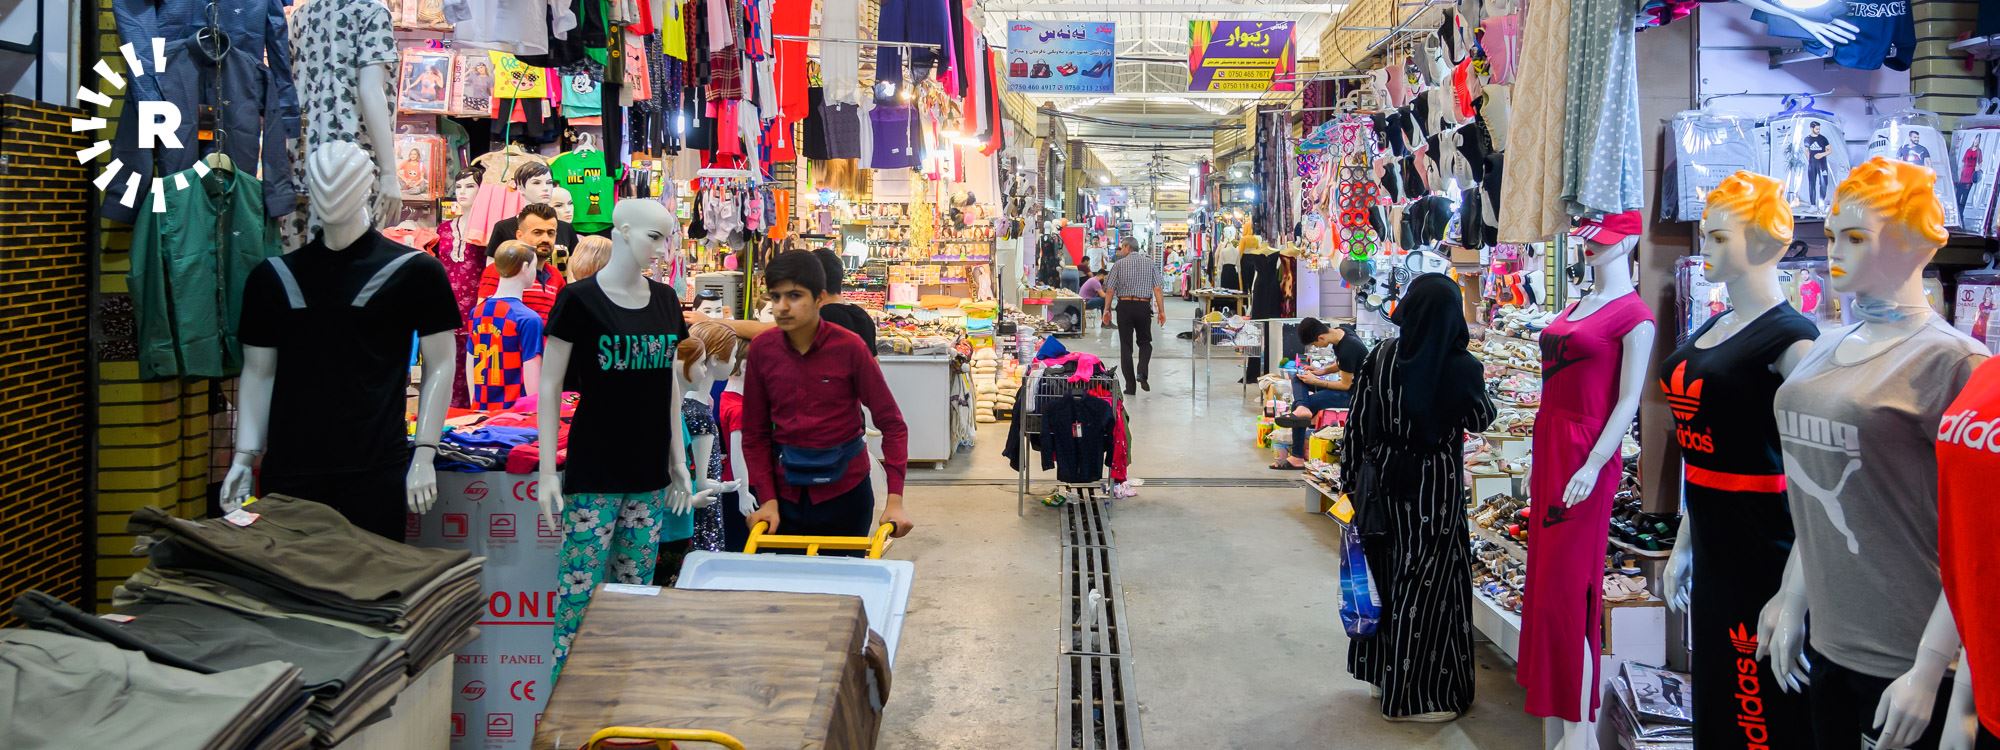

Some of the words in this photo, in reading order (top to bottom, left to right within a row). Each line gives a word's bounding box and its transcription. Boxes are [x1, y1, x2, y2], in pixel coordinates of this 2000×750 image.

[1848, 1, 1906, 17] ERSACE
[474, 344, 500, 385] 21
[598, 335, 677, 371] SUMME
[454, 655, 488, 664] OSITE
[500, 655, 544, 665] PANEL
[1735, 657, 1771, 750] didas
